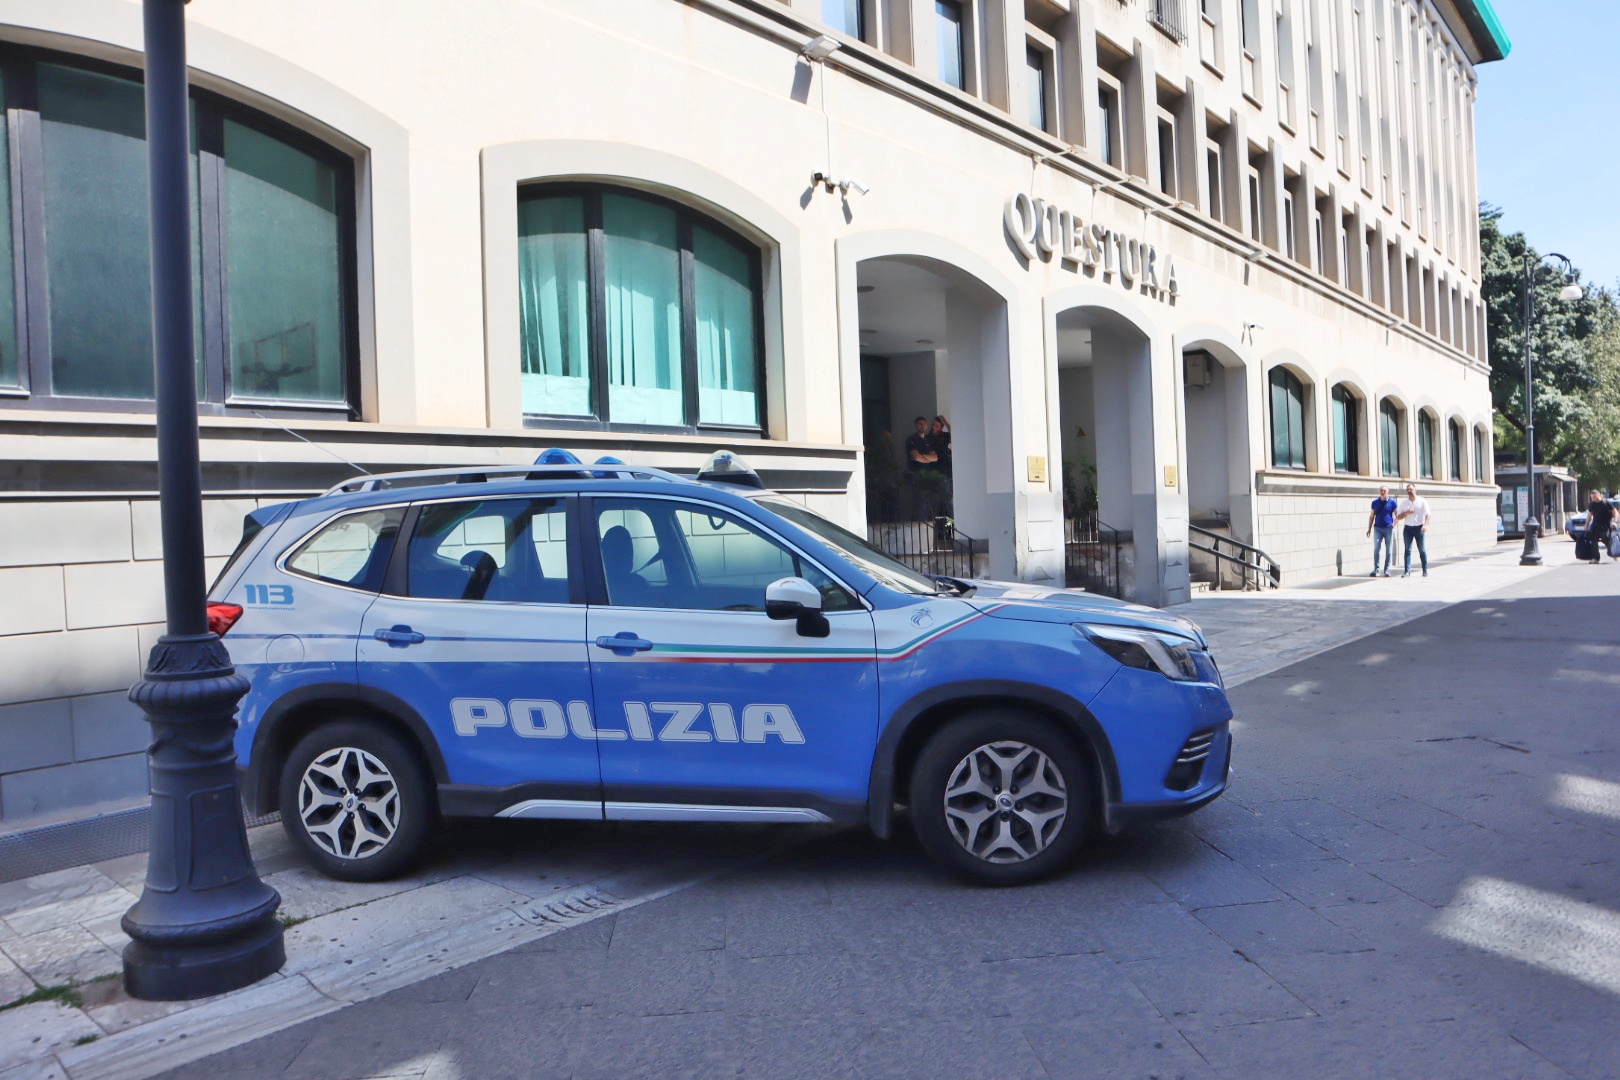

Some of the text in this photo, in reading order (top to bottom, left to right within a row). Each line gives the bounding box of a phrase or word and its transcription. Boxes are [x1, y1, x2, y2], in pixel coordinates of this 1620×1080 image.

[1003, 193, 1180, 297] QUESTURA
[244, 584, 295, 605] 113
[450, 698, 805, 744] POLIZIA
